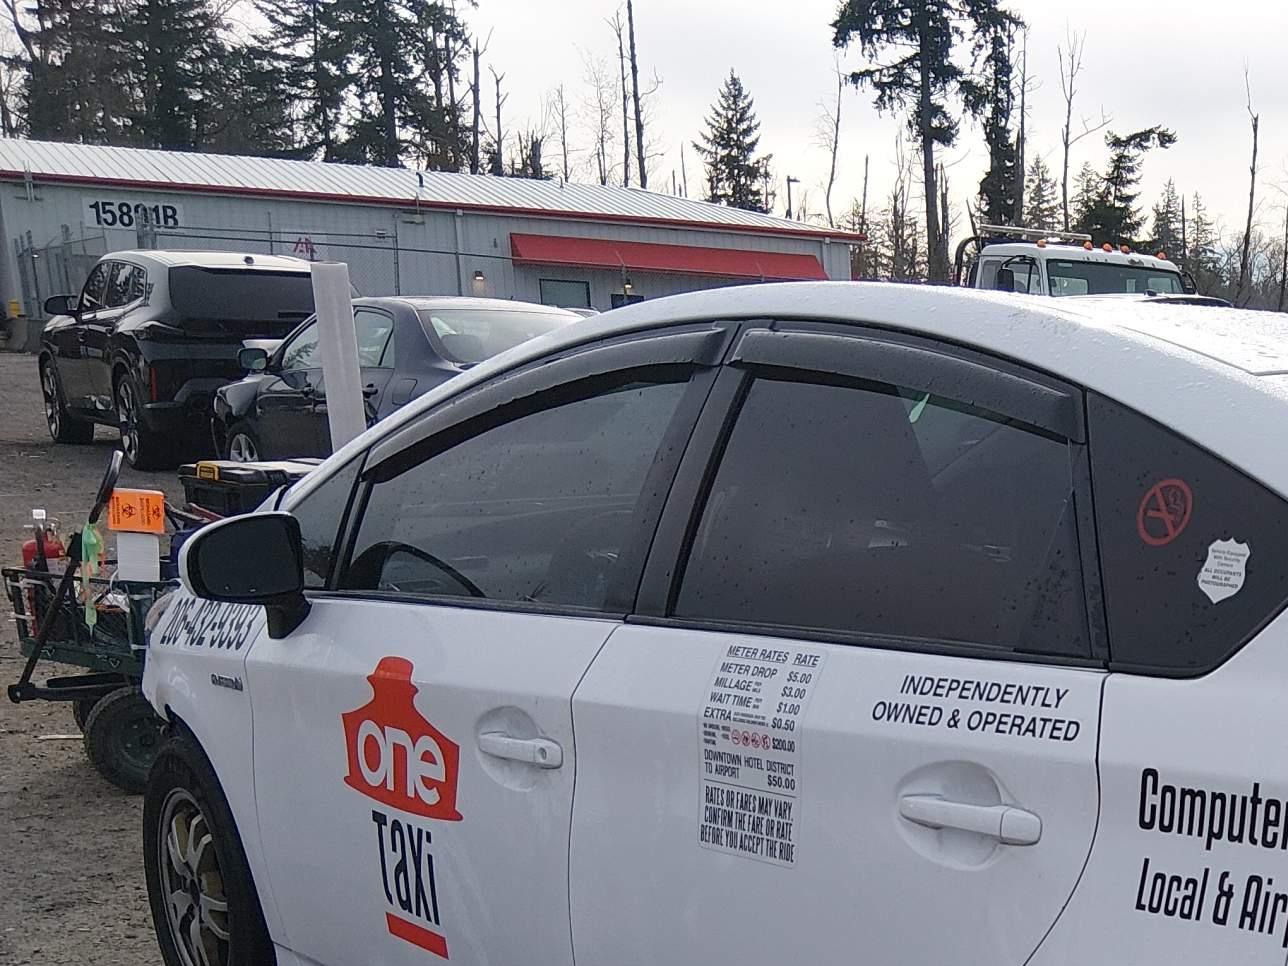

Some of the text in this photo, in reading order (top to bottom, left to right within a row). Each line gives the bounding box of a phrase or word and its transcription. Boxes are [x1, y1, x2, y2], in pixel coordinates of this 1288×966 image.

[727, 645, 821, 666] METER RATES RATE
[714, 677, 753, 692] MILLAGE
[781, 686, 806, 699] $3.00
[720, 662, 812, 684] METER DROP $5.00
[710, 692, 733, 704] WAIT
[732, 694, 753, 709] TIME
[777, 702, 800, 715] $1.00
[900, 674, 1068, 709] INDEPENDENTLY
[704, 706, 732, 721] EXTRA
[771, 717, 795, 732] $0.50
[871, 701, 1080, 743] OWNED & OPERATED
[357, 719, 446, 806] one
[704, 749, 794, 776] DOWNTOWN HOTEL DISTRICT
[704, 762, 796, 791] TO AIRPORT $50.00
[705, 786, 794, 822] RATES OR FARES MAY VARY.
[704, 805, 793, 841] CONFIRM THE FARE OR RATE
[700, 824, 795, 863] BEFORE YOU ACCEPT THE RIDE
[1135, 858, 1209, 921] Local
[1213, 871, 1234, 926] &
